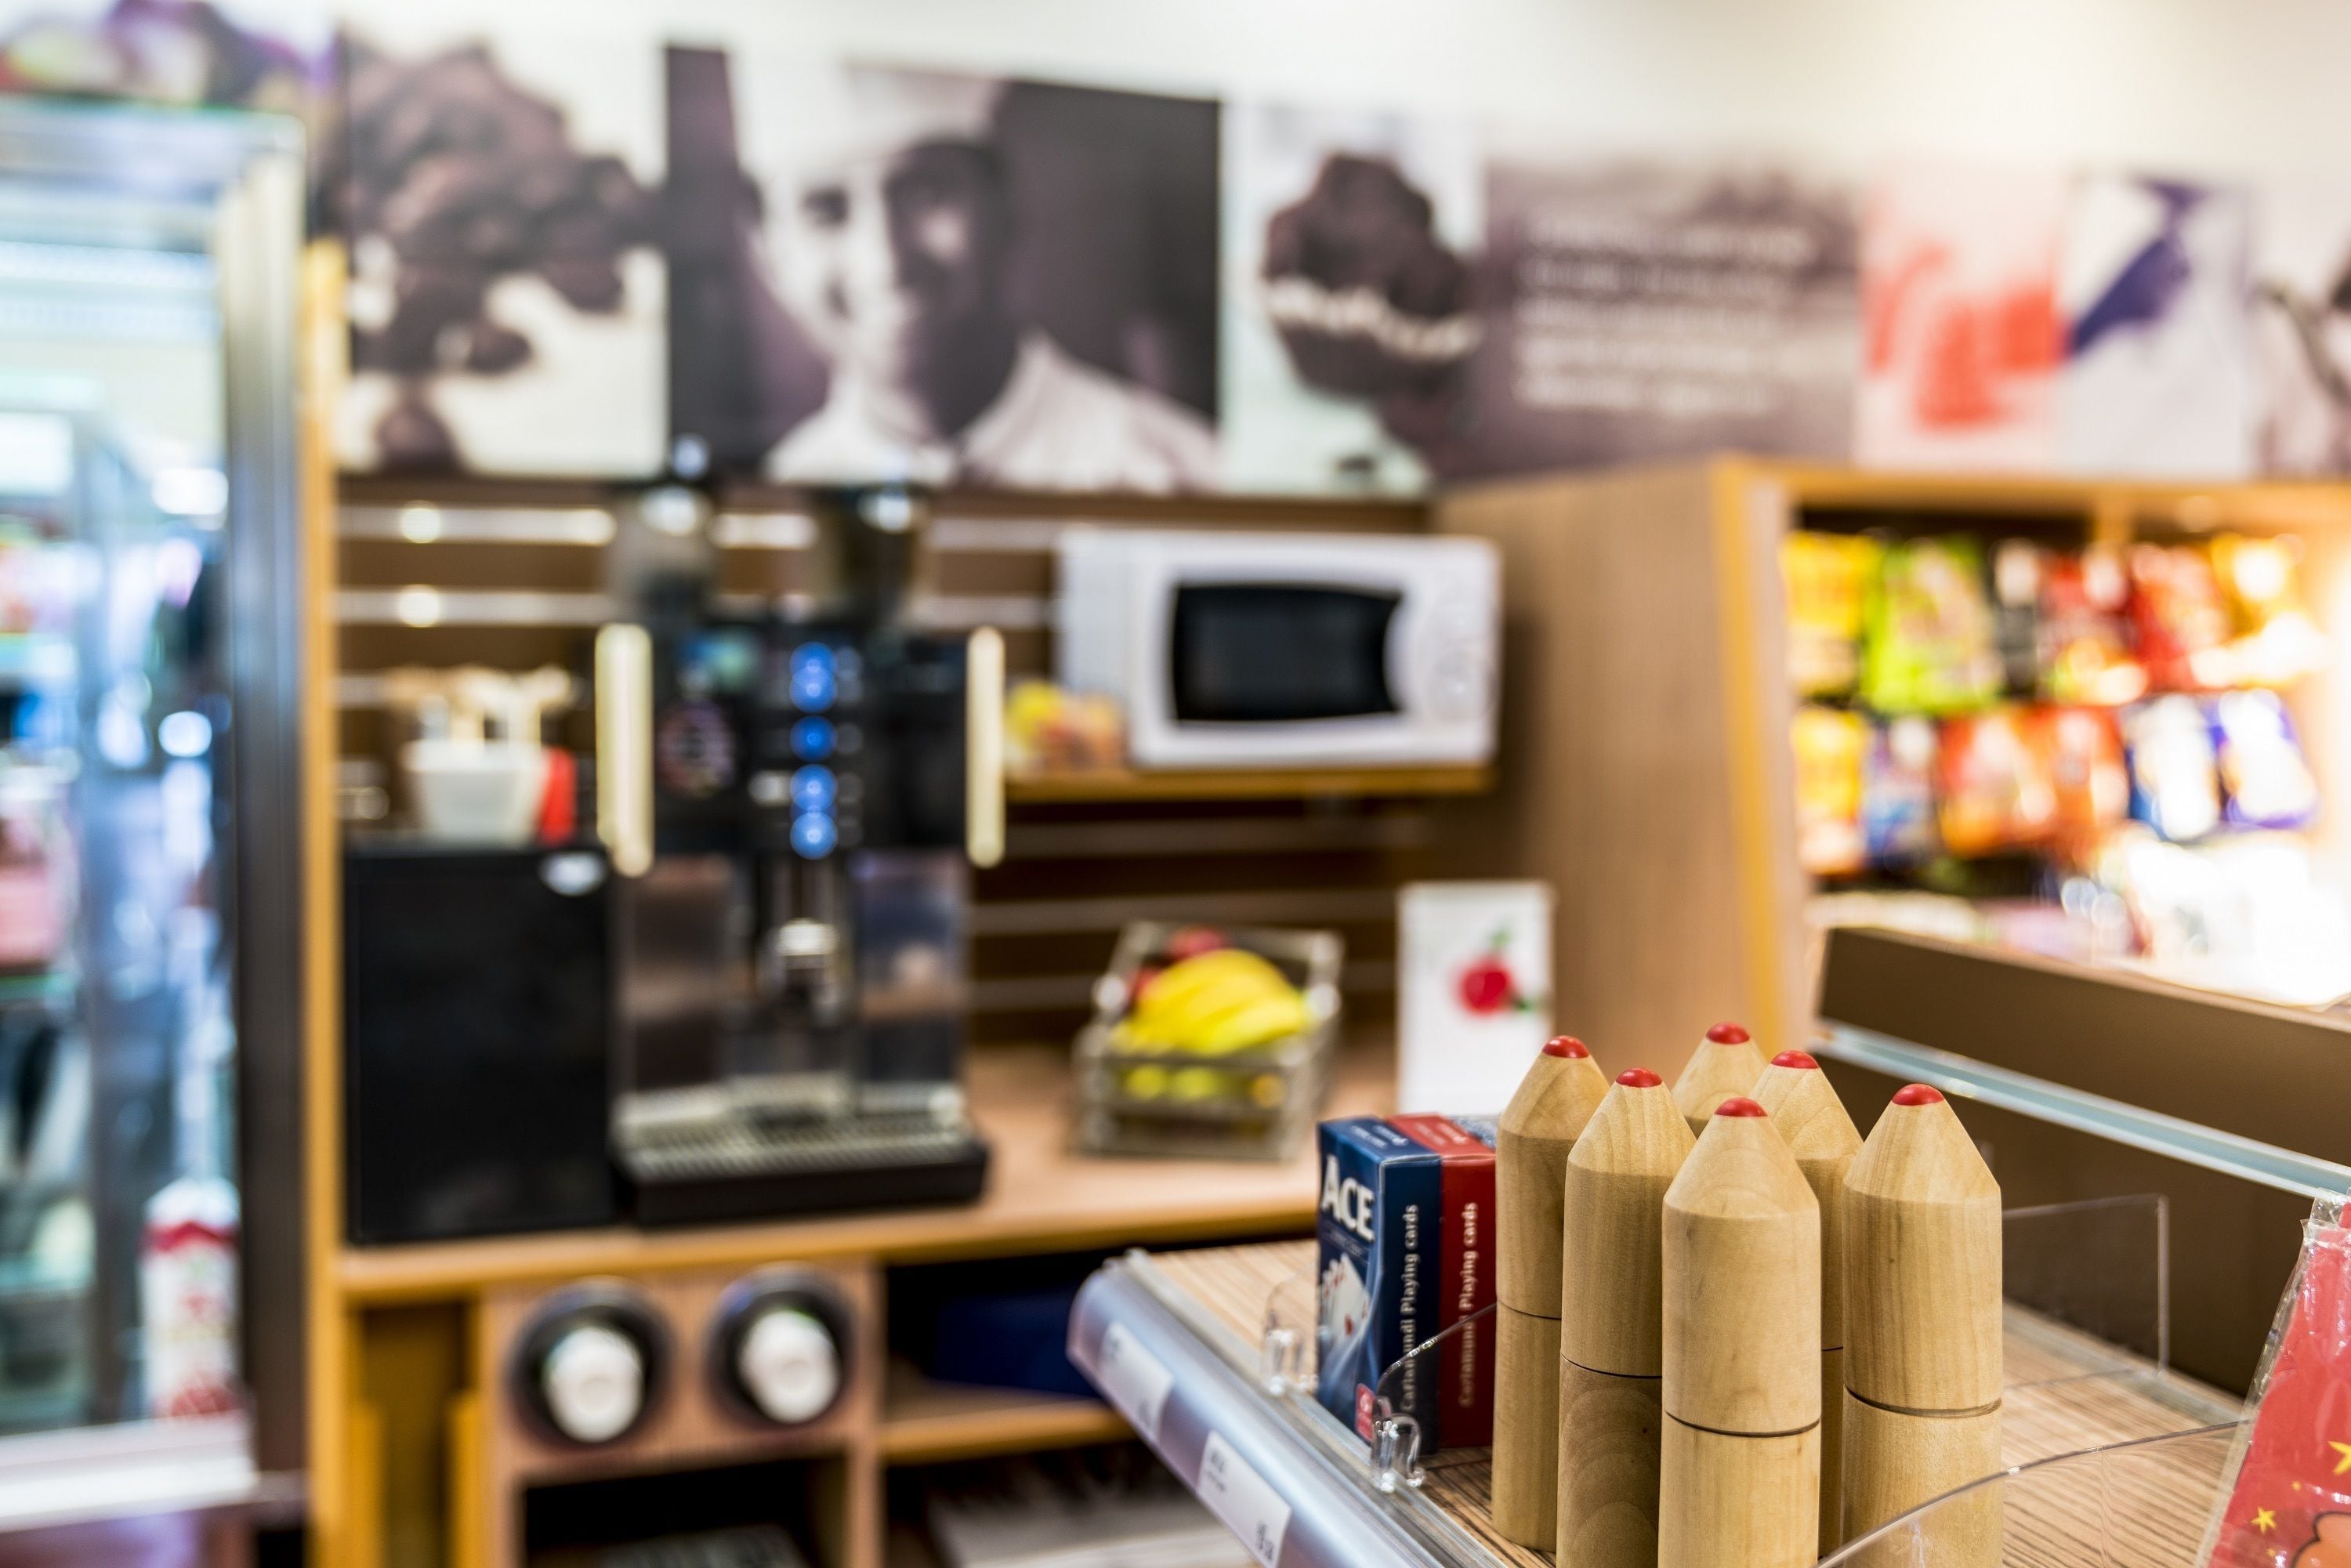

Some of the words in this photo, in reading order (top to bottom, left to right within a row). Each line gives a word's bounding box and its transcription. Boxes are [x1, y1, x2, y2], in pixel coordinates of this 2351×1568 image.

[1320, 1153, 1375, 1242] ACE
[1402, 1204, 1419, 1249] cards
[1462, 1202, 1478, 1248] cards
[1400, 1253, 1420, 1315] Playing
[1458, 1251, 1479, 1310] Playing
